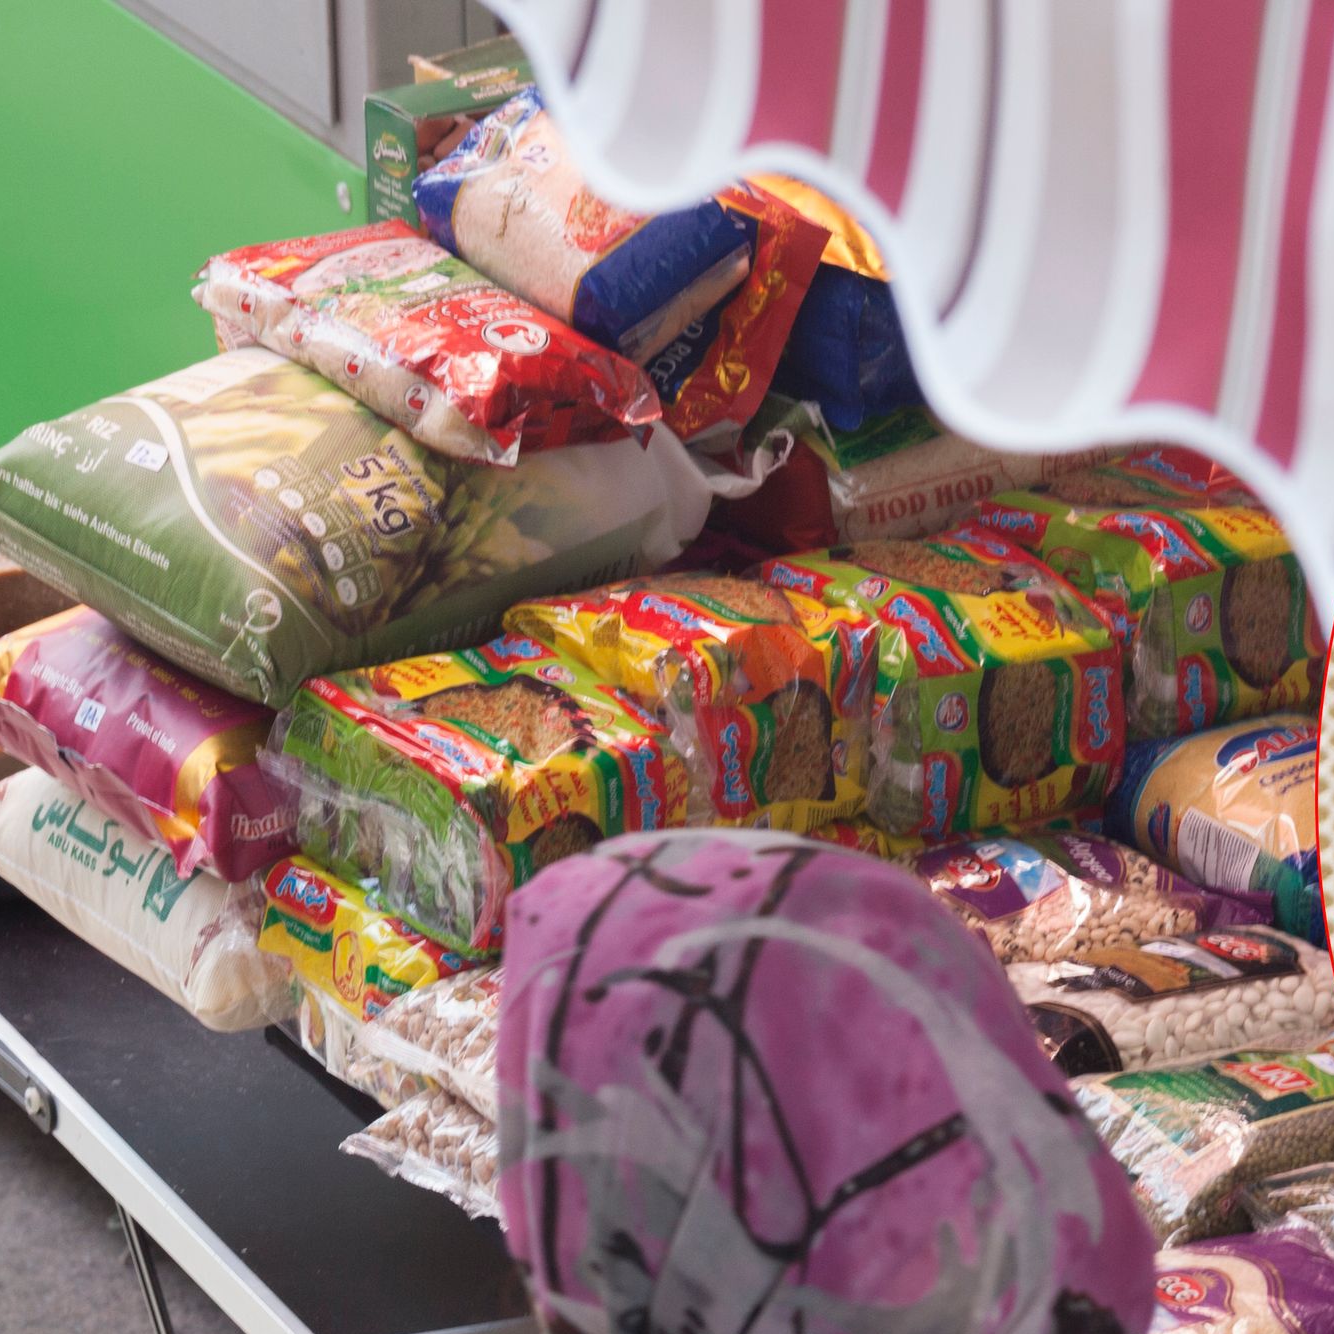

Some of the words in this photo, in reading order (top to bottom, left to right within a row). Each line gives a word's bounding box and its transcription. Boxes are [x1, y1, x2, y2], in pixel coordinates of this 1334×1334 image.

[84, 415, 122, 441] RIZ
[867, 493, 927, 525] HOD
[934, 474, 994, 508] HOD
[63, 501, 89, 526] siehe
[89, 514, 132, 549] Aufdruck
[132, 537, 171, 571] Etikette
[46, 832, 69, 852] ABU
[69, 846, 98, 872] KASS
[1156, 1275, 1200, 1301] ece
